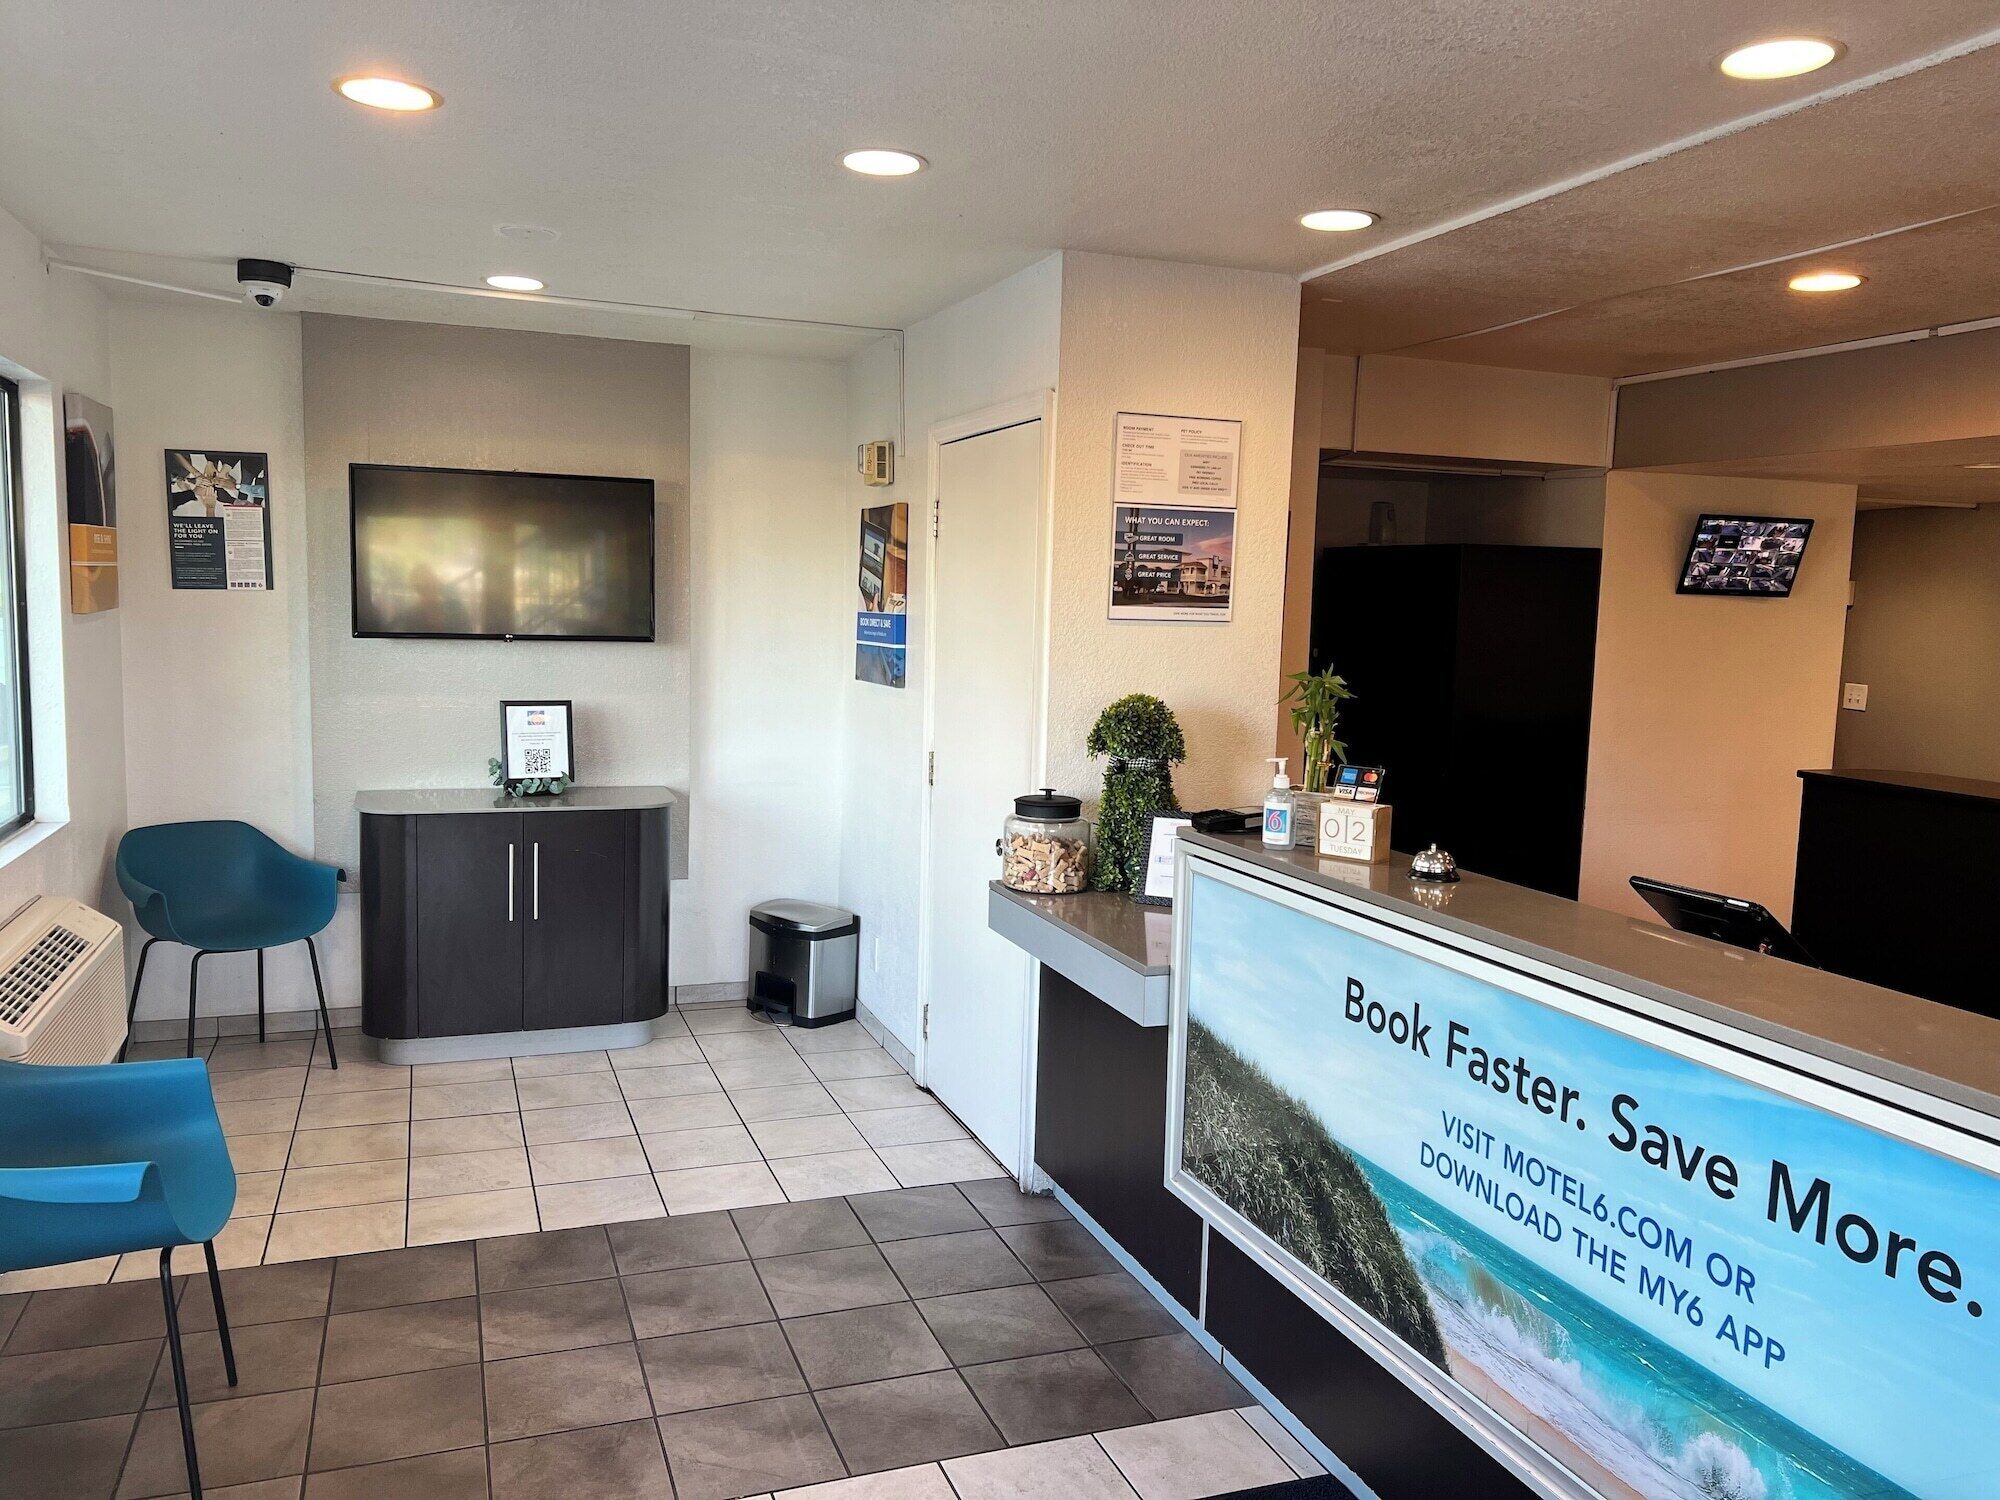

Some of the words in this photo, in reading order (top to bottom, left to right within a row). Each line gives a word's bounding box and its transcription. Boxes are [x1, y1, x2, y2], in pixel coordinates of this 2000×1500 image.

[1124, 516, 1145, 524] WHAT
[1147, 517, 1163, 525] YOU
[1164, 518, 1180, 526] CAN
[1181, 519, 1210, 527] EXPECT:
[859, 617, 870, 627] BOOK
[1338, 787, 1353, 795] VISA
[1338, 807, 1355, 816] MAY
[1268, 810, 1283, 832] 6
[1330, 844, 1363, 855] TUESDAY
[1344, 976, 1430, 1058] Book
[1446, 1019, 1587, 1131] Faster.
[1607, 1093, 1740, 1200] Save
[1767, 1159, 1984, 1318] More.
[1441, 1110, 1495, 1159] VISIT
[1502, 1141, 1693, 1269] MOTEL6.COM
[1706, 1252, 1756, 1304] OR
[1419, 1140, 1563, 1243] DOWNLOAD
[1572, 1230, 1626, 1284] THE
[1638, 1263, 1705, 1328] MY6
[1714, 1313, 1787, 1370] APP
